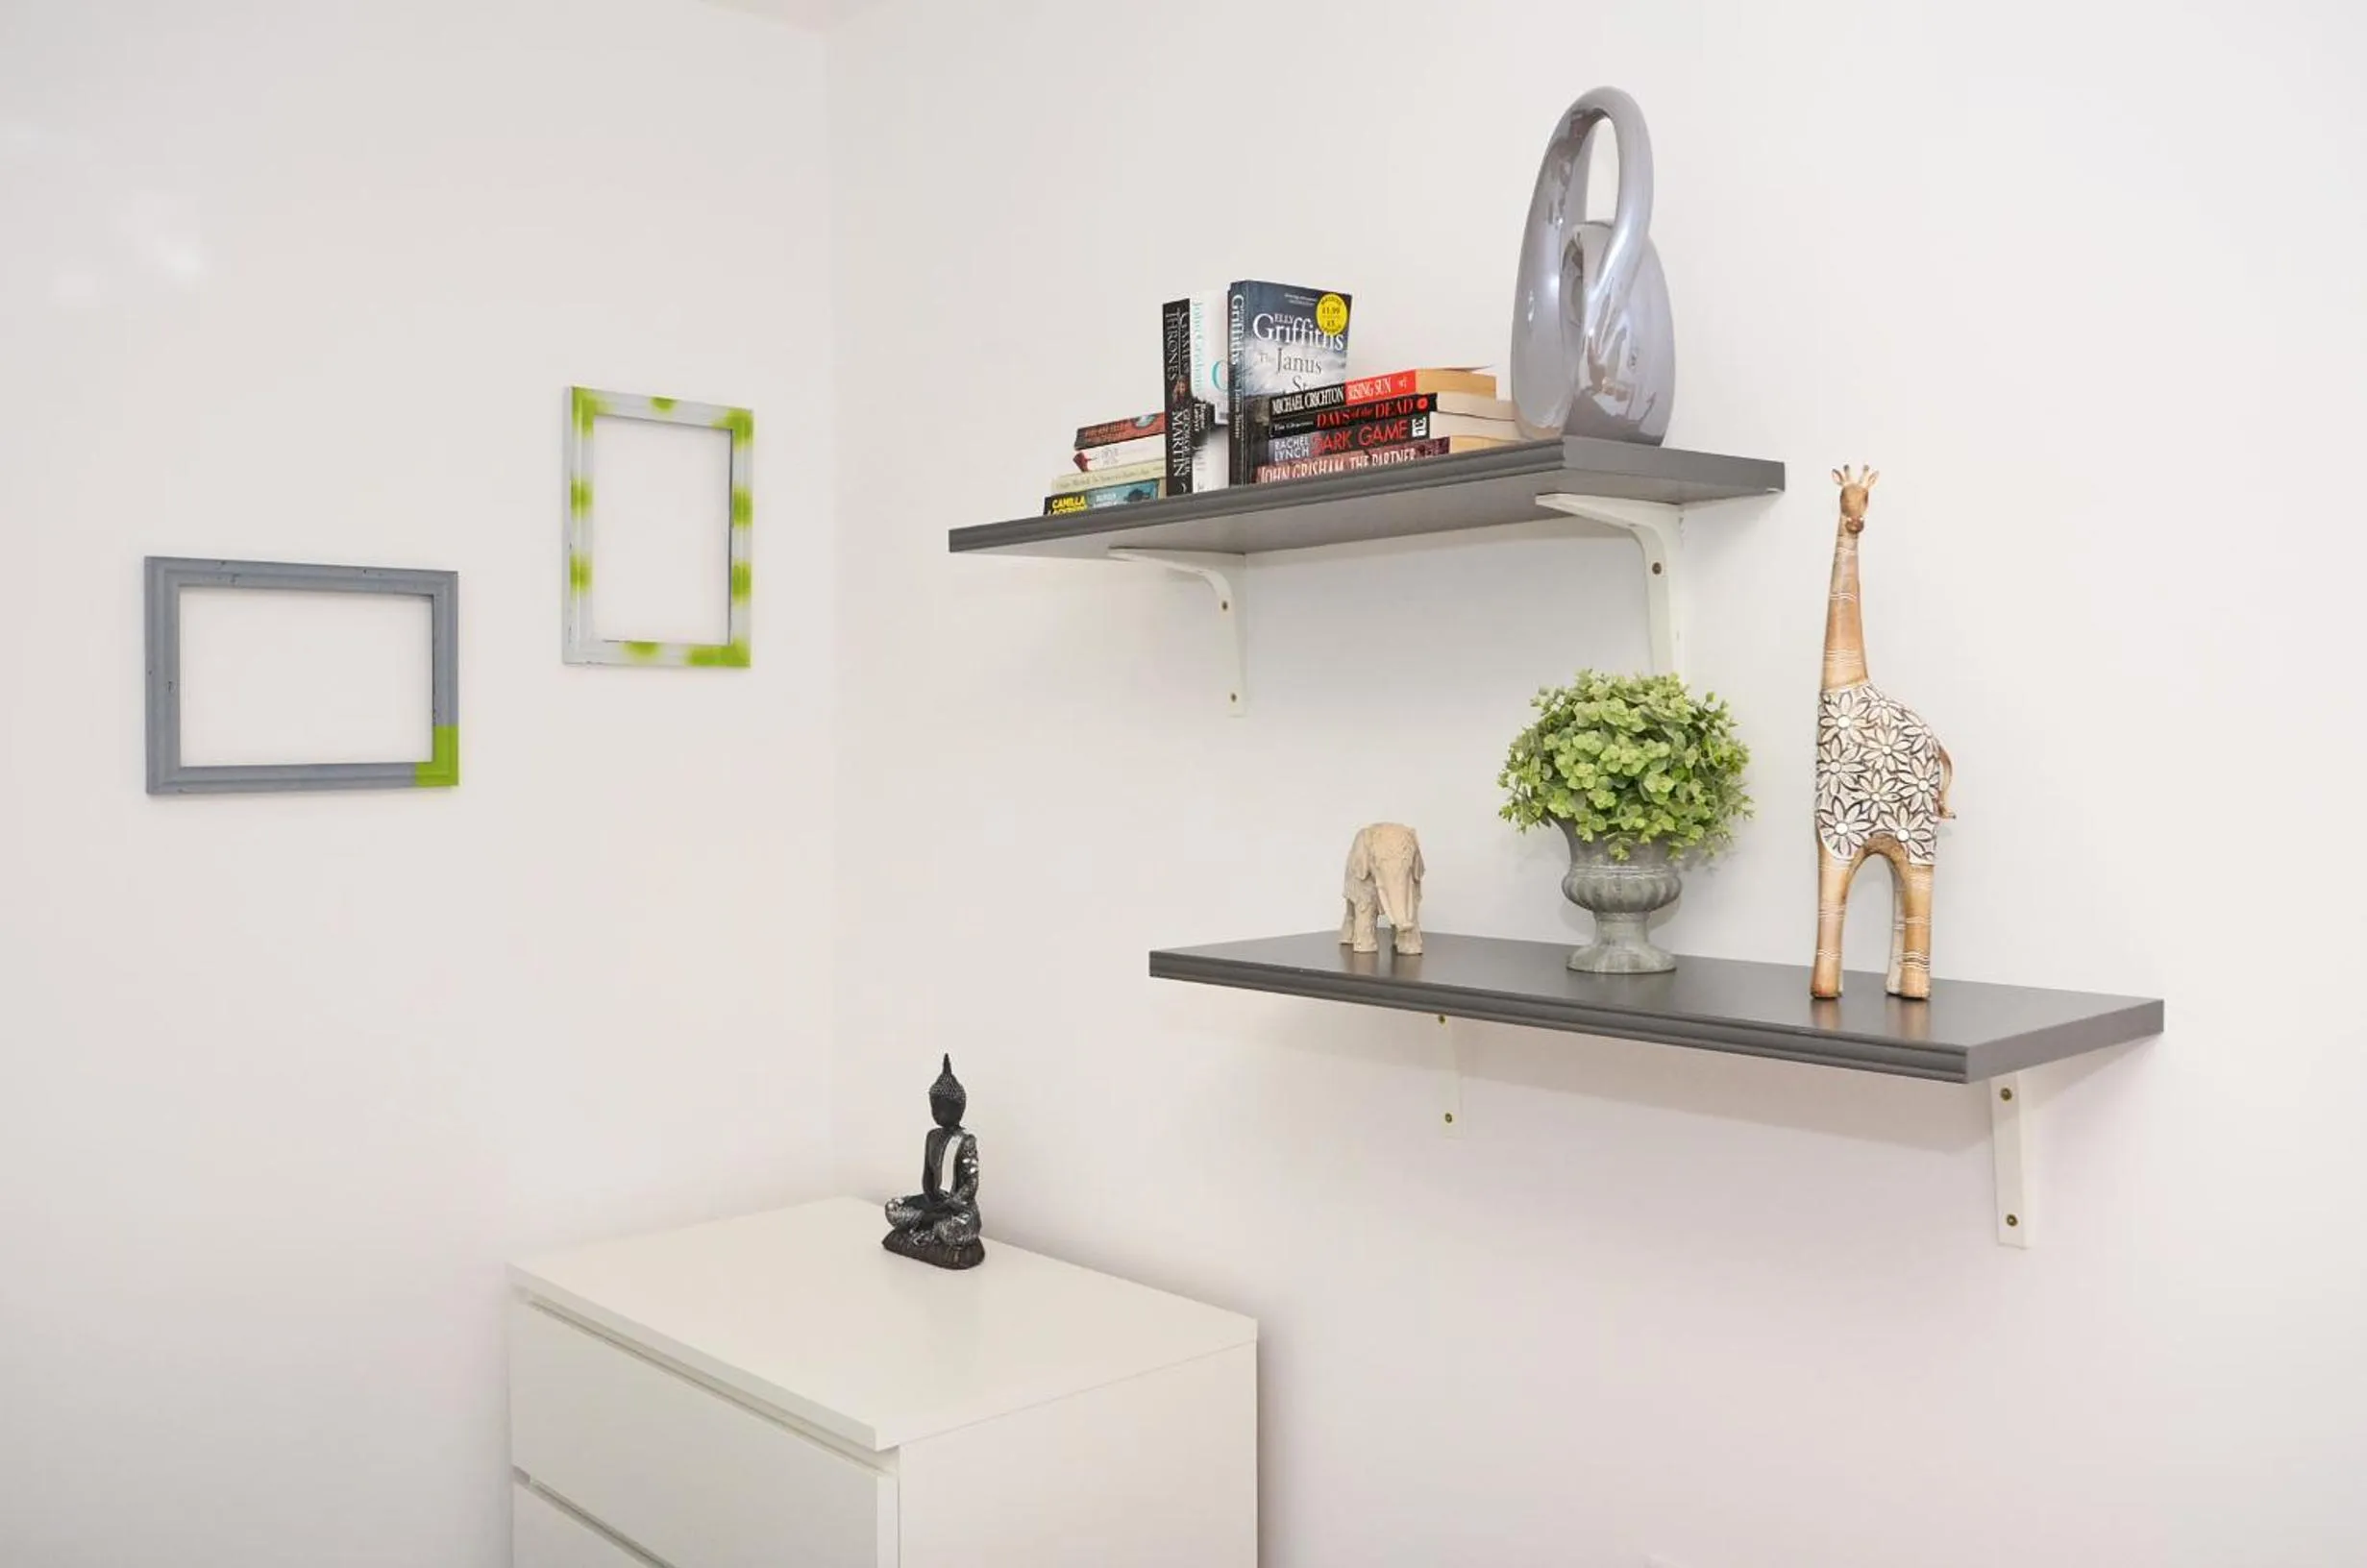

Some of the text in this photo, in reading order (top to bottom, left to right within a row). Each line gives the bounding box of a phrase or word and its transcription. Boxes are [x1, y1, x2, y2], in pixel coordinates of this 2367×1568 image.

[1231, 294, 1245, 365] Griffiths
[1252, 313, 1344, 351] Griffiths
[1274, 313, 1294, 324] ELLY
[1165, 312, 1178, 380] THRONES
[1276, 347, 1322, 374] Janus
[1271, 386, 1344, 414] MICHAEL CRICHTON
[1347, 376, 1392, 400] RISING SUN
[1317, 410, 1349, 429] DAYS
[1375, 399, 1414, 418] DEAD
[1172, 410, 1183, 477] MARTIN
[1274, 435, 1310, 452] RACHEL
[1311, 419, 1408, 455] DARK GAME
[1258, 464, 1291, 483] JOHN
[1349, 453, 1369, 470] THE
[1371, 448, 1416, 466] PARTNER
[1274, 446, 1310, 462] LYNCH
